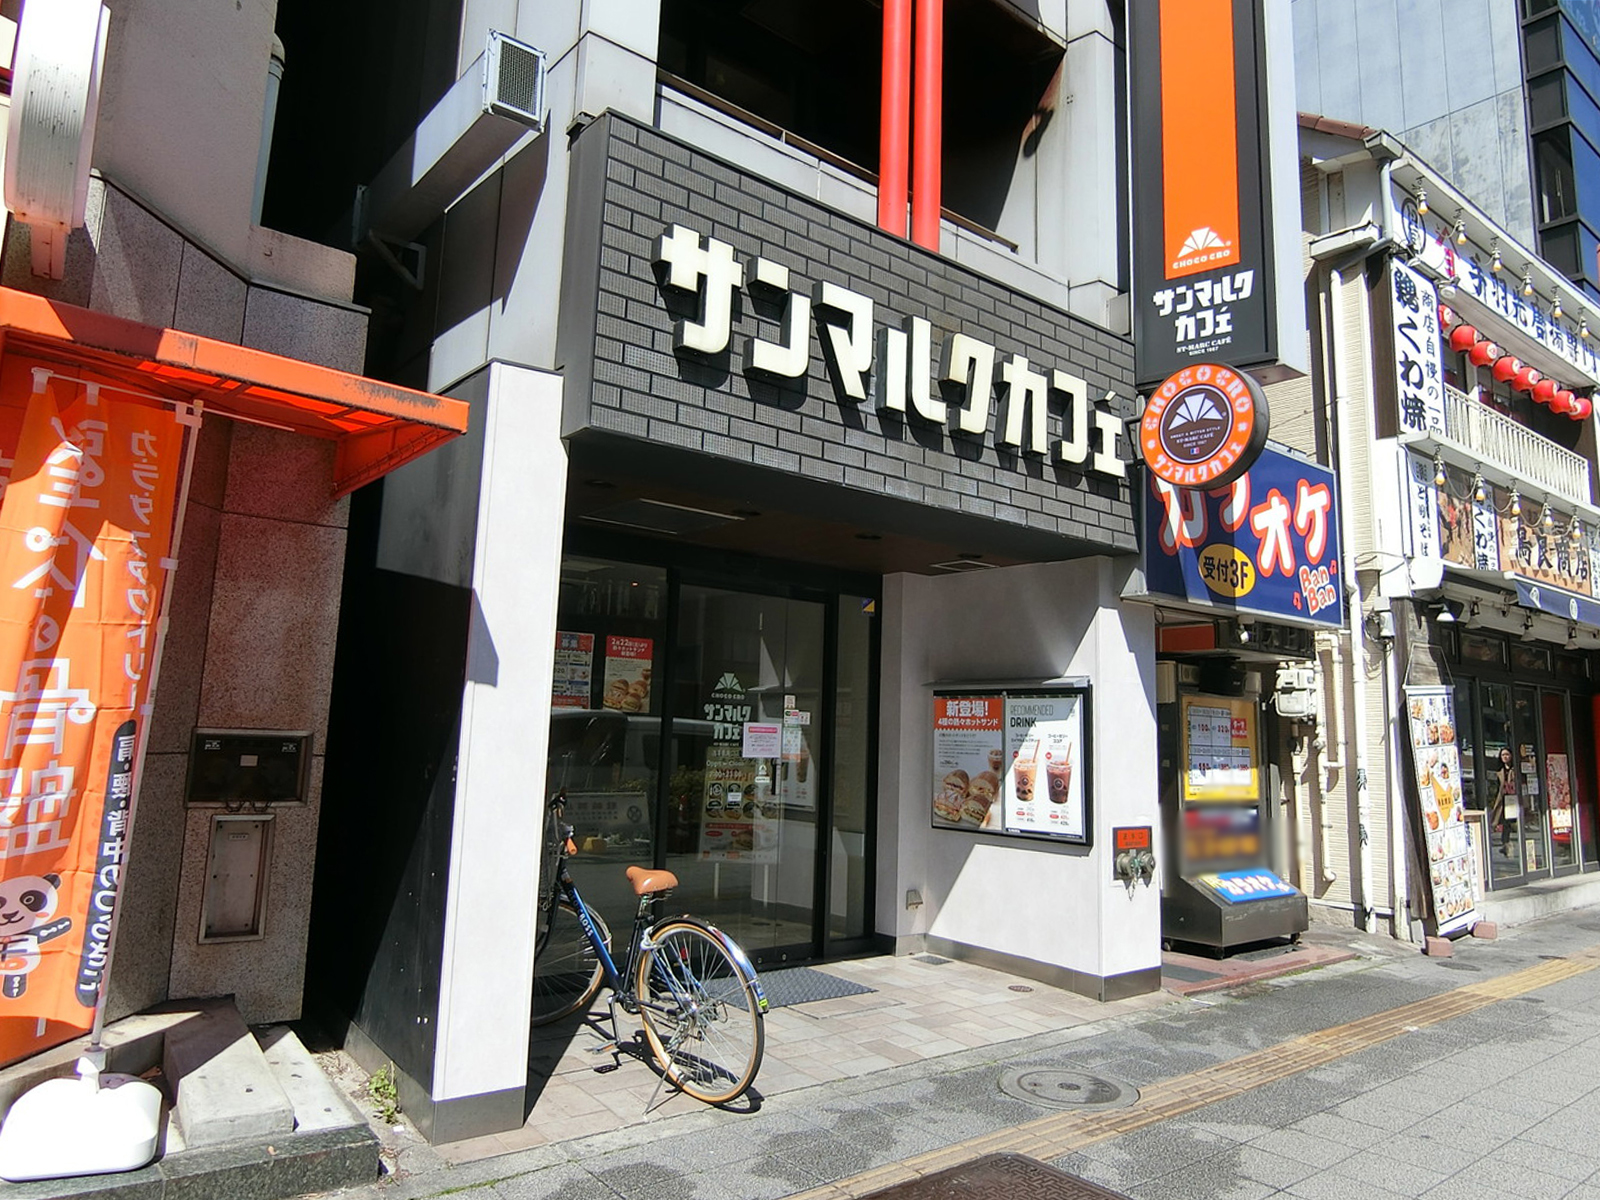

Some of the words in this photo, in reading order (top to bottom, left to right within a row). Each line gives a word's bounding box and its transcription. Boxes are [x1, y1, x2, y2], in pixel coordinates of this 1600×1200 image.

[1172, 255, 1207, 269] CHOCO
[1209, 249, 1231, 260] CRO
[1153, 269, 1254, 317] サンマルク
[1175, 306, 1232, 343] カフェ
[656, 223, 1126, 478] サンマルクカフェ
[1203, 555, 1249, 590] 受付3F
[1299, 566, 1329, 595] Ban
[1307, 585, 1336, 614] Ban
[704, 703, 752, 721] サンマルク
[946, 700, 988, 717] 新登場!
[1010, 705, 1054, 716] RECOMMENDED
[1010, 717, 1036, 728] DRINK
